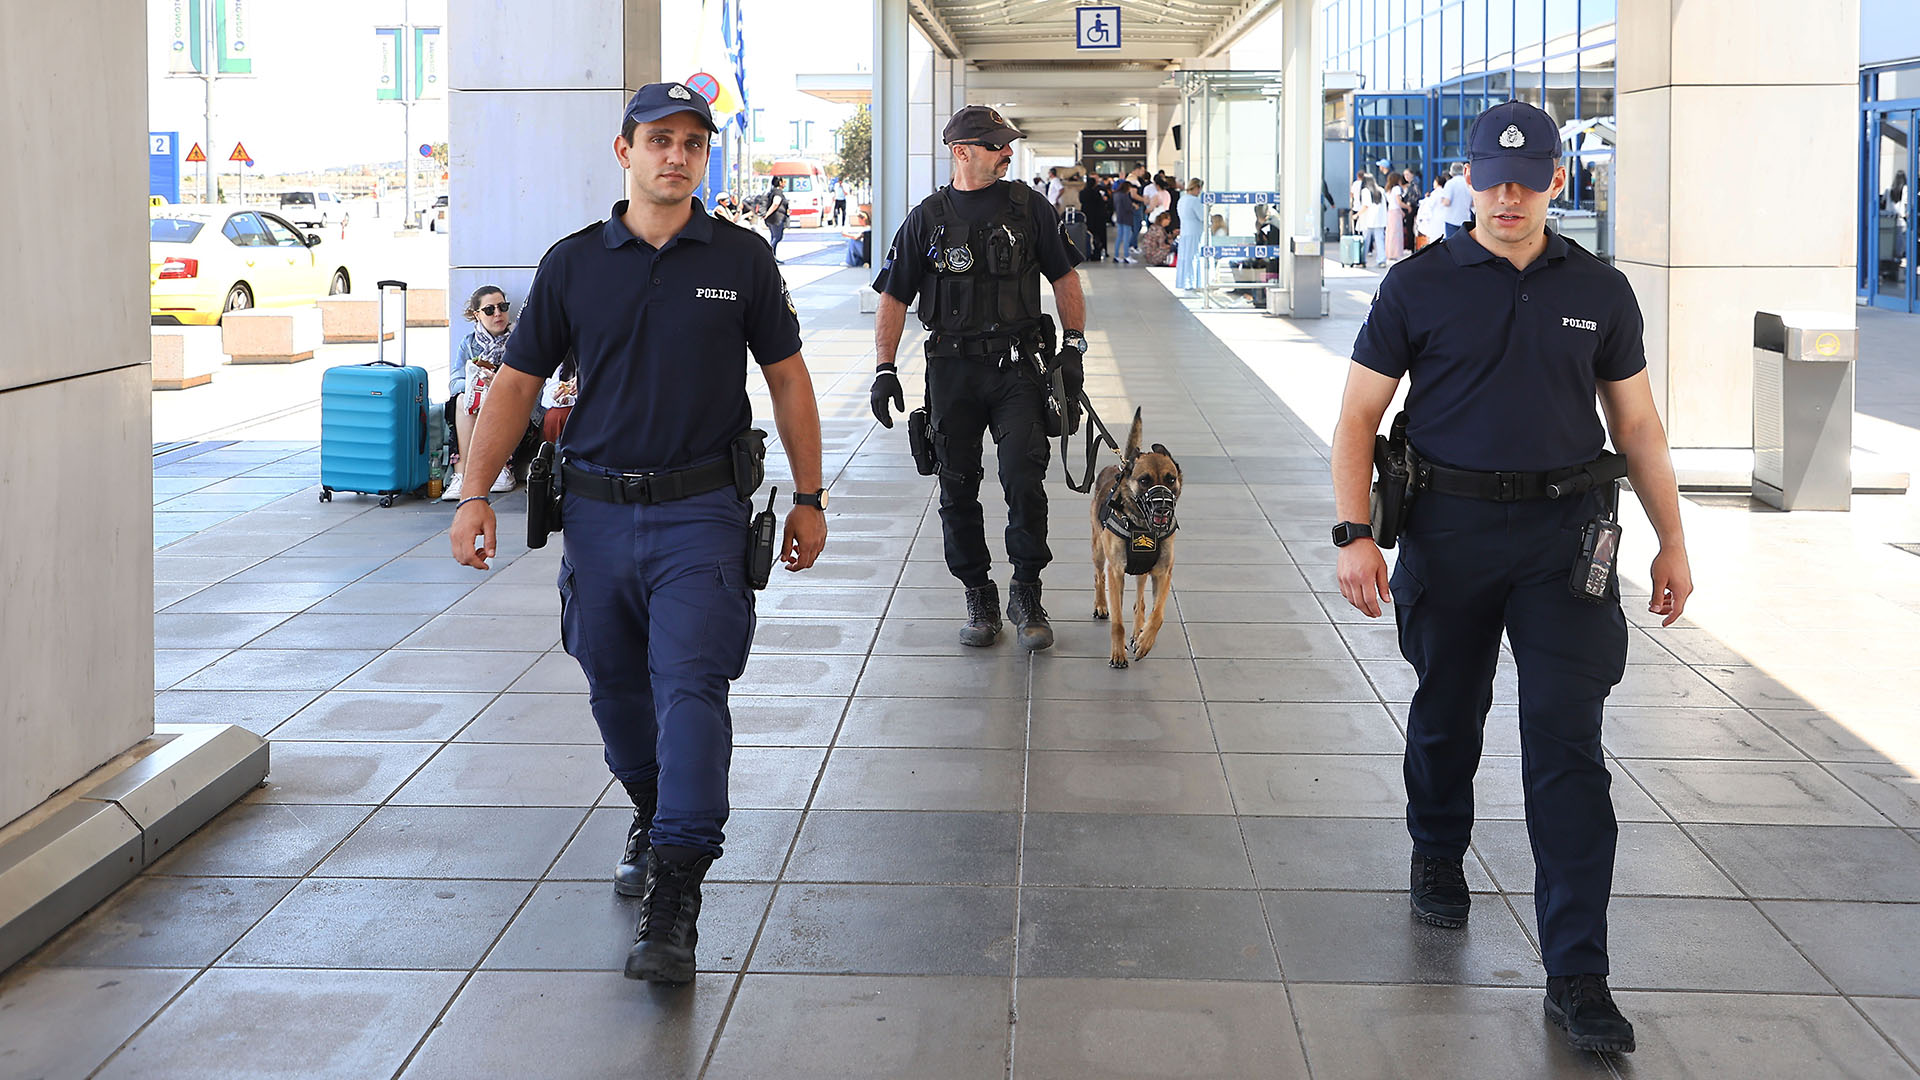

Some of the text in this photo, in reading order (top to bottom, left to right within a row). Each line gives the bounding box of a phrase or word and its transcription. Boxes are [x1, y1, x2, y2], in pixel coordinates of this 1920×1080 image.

[174, 0, 182, 38] COSMOT
[235, 0, 243, 38] COSMOT
[156, 138, 164, 152] 2
[1107, 140, 1141, 148] VENETI
[1243, 193, 1250, 203] 1
[1243, 247, 1250, 257] 1
[695, 288, 738, 301] POLICE
[1561, 317, 1598, 331] POLICE
